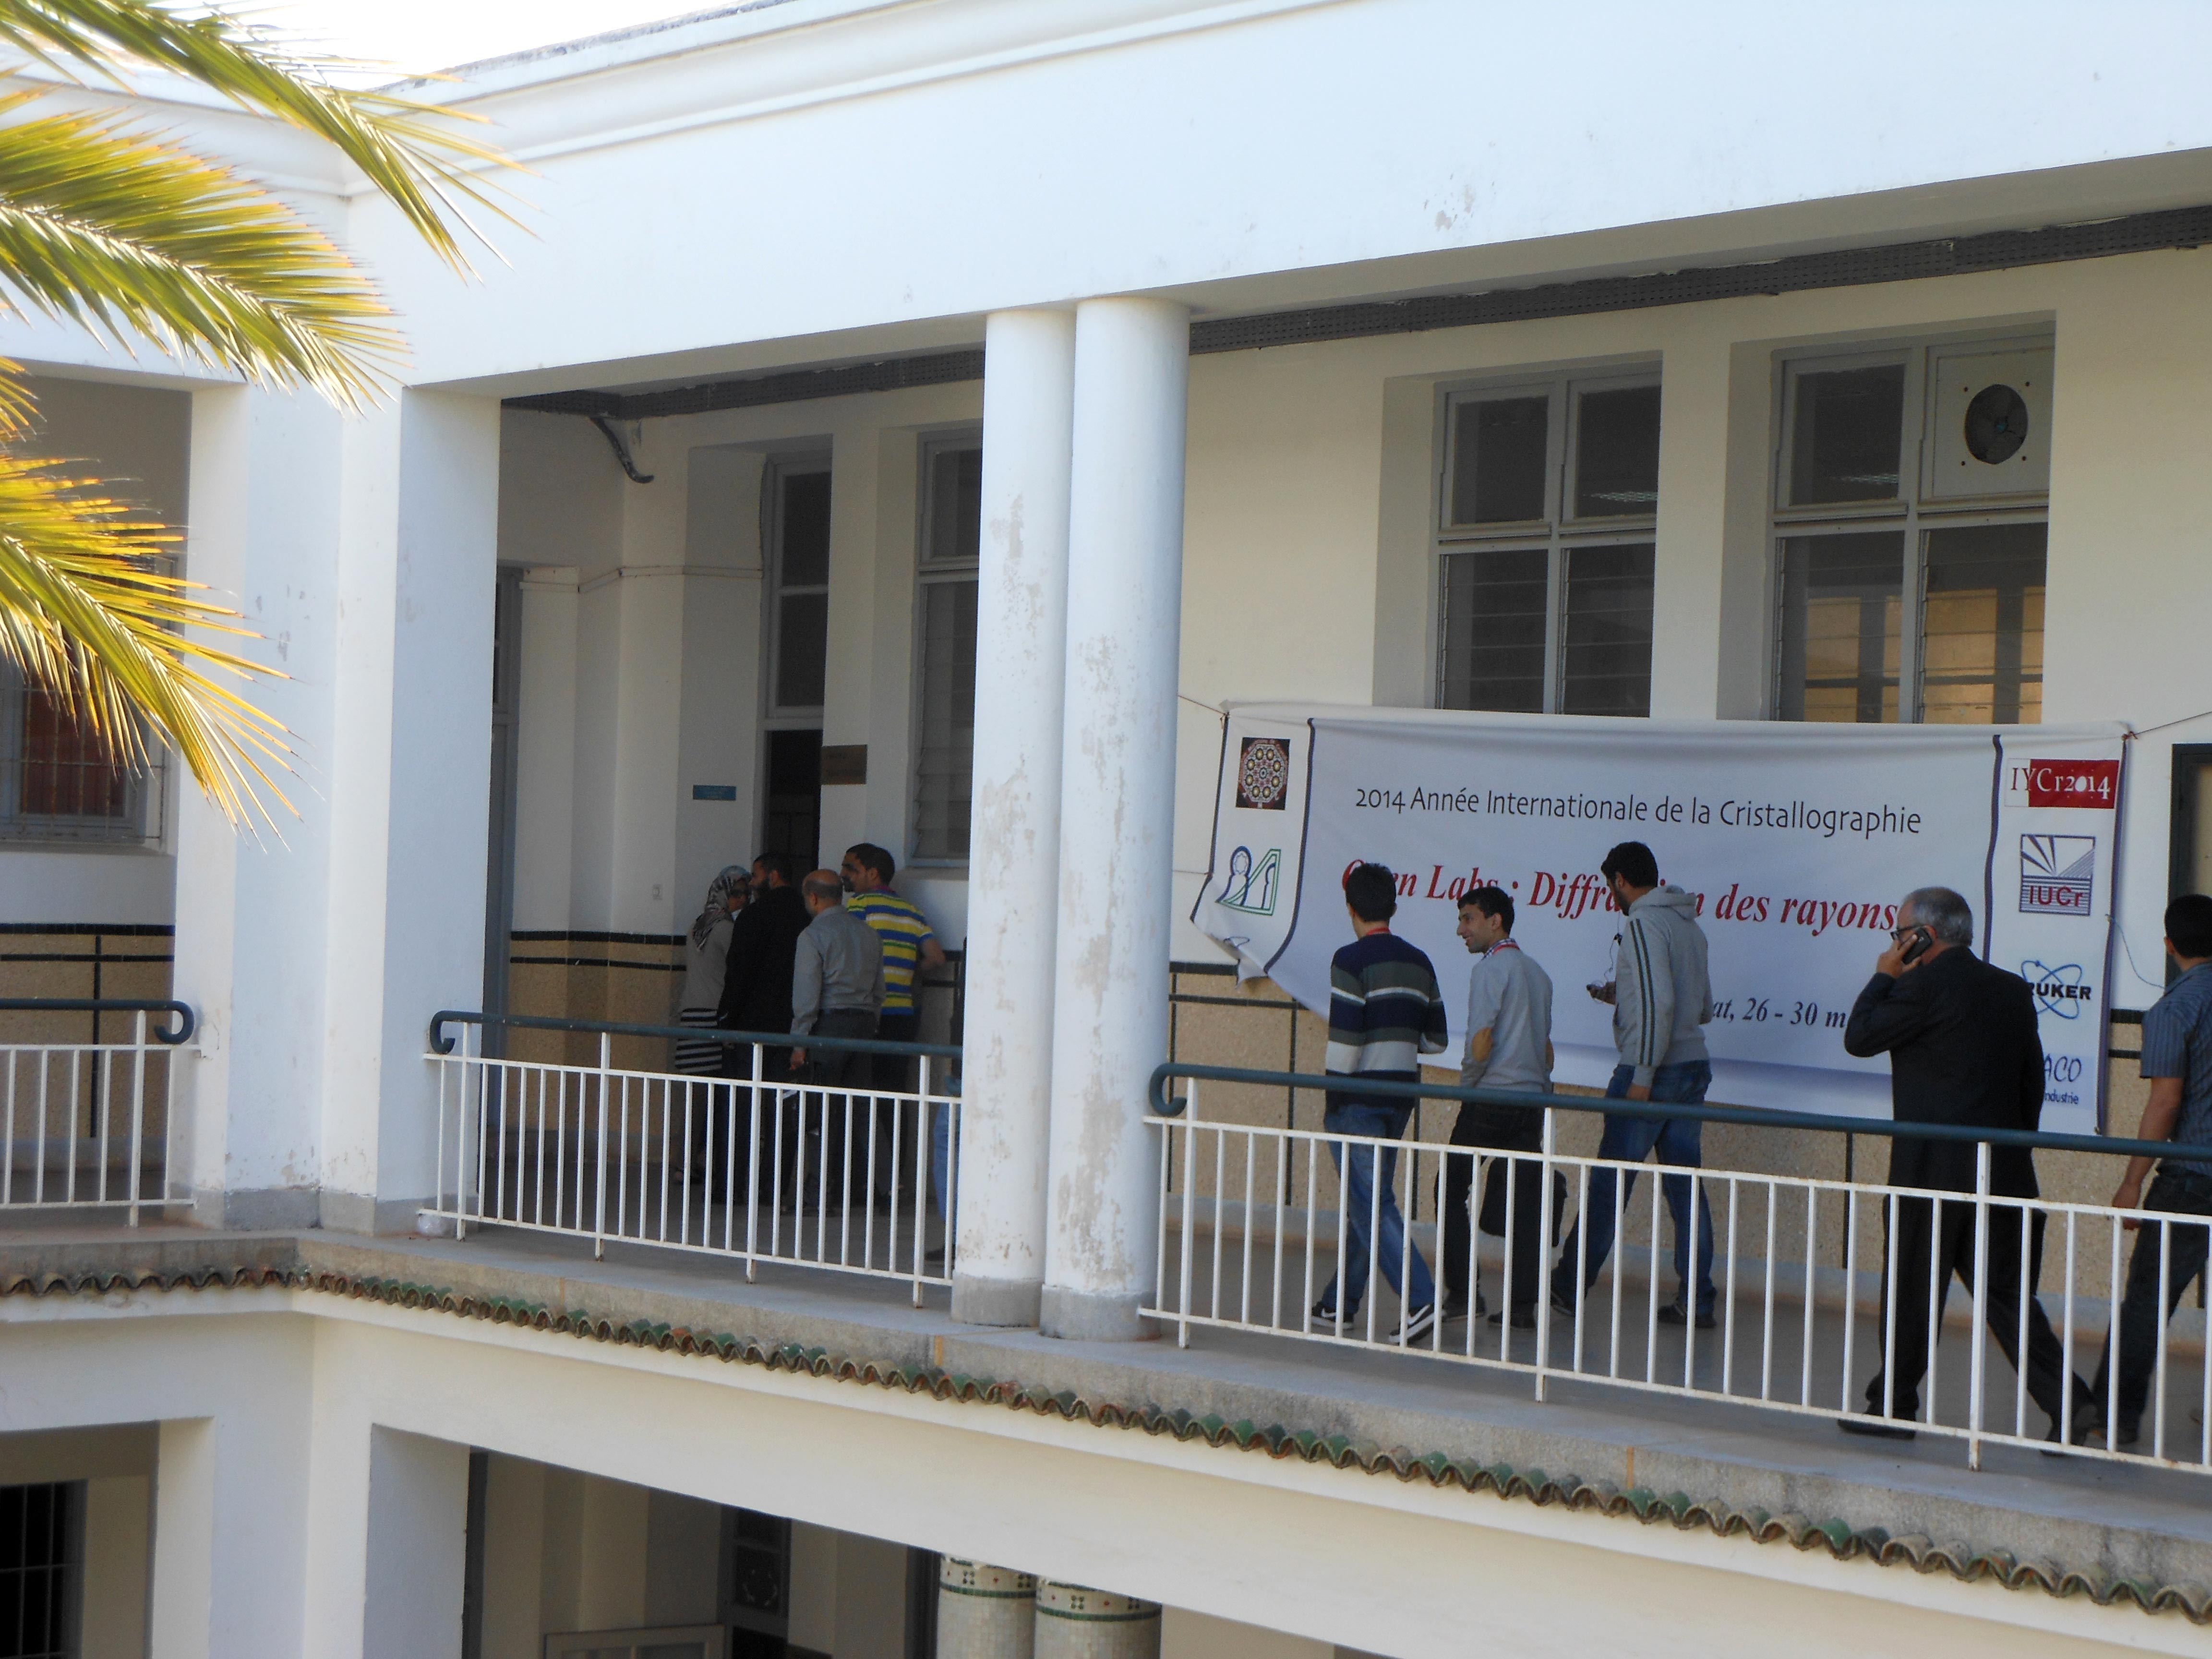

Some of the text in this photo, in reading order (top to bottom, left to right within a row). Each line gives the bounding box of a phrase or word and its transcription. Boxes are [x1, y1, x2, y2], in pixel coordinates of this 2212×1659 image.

[2010, 767, 2111, 800] IYCr2014
[1356, 786, 1921, 839] 2014 Année Internationale de la Cristallographie
[1715, 883, 1770, 922] des
[1780, 898, 1898, 937] rayons
[2029, 885, 2083, 907] IUCr
[1742, 997, 1771, 1022] 26
[1790, 1001, 1818, 1025] 30
